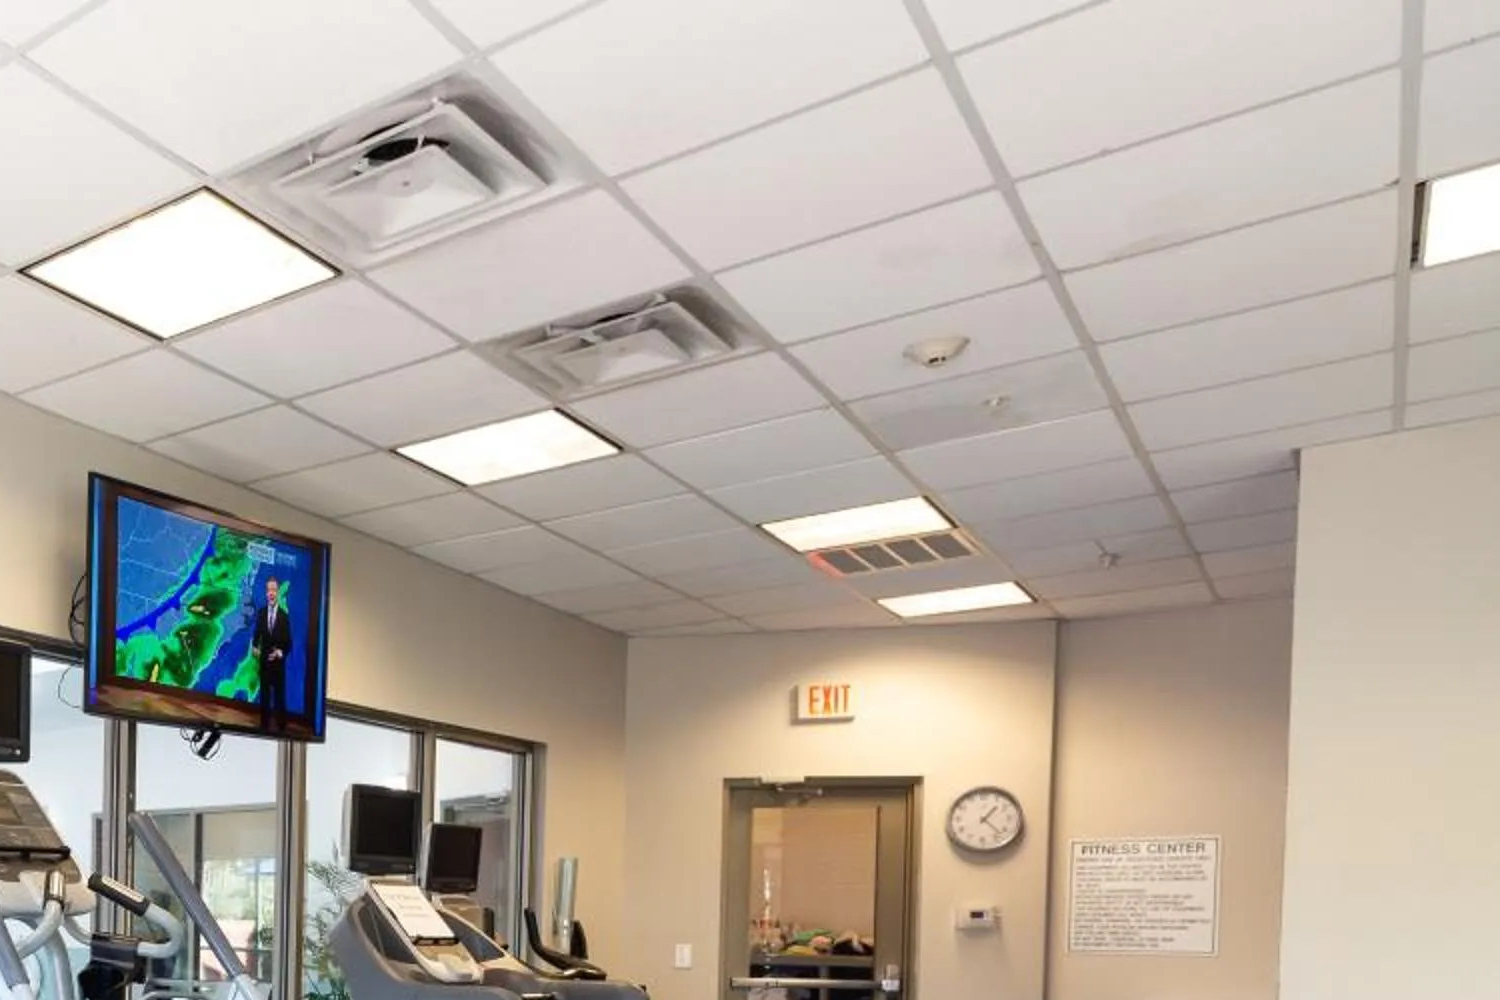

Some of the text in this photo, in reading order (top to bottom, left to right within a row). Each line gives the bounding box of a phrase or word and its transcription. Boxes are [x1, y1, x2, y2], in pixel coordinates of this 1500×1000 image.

[808, 684, 851, 715] EXIT
[1080, 841, 1206, 856] FITNESS CENTER
